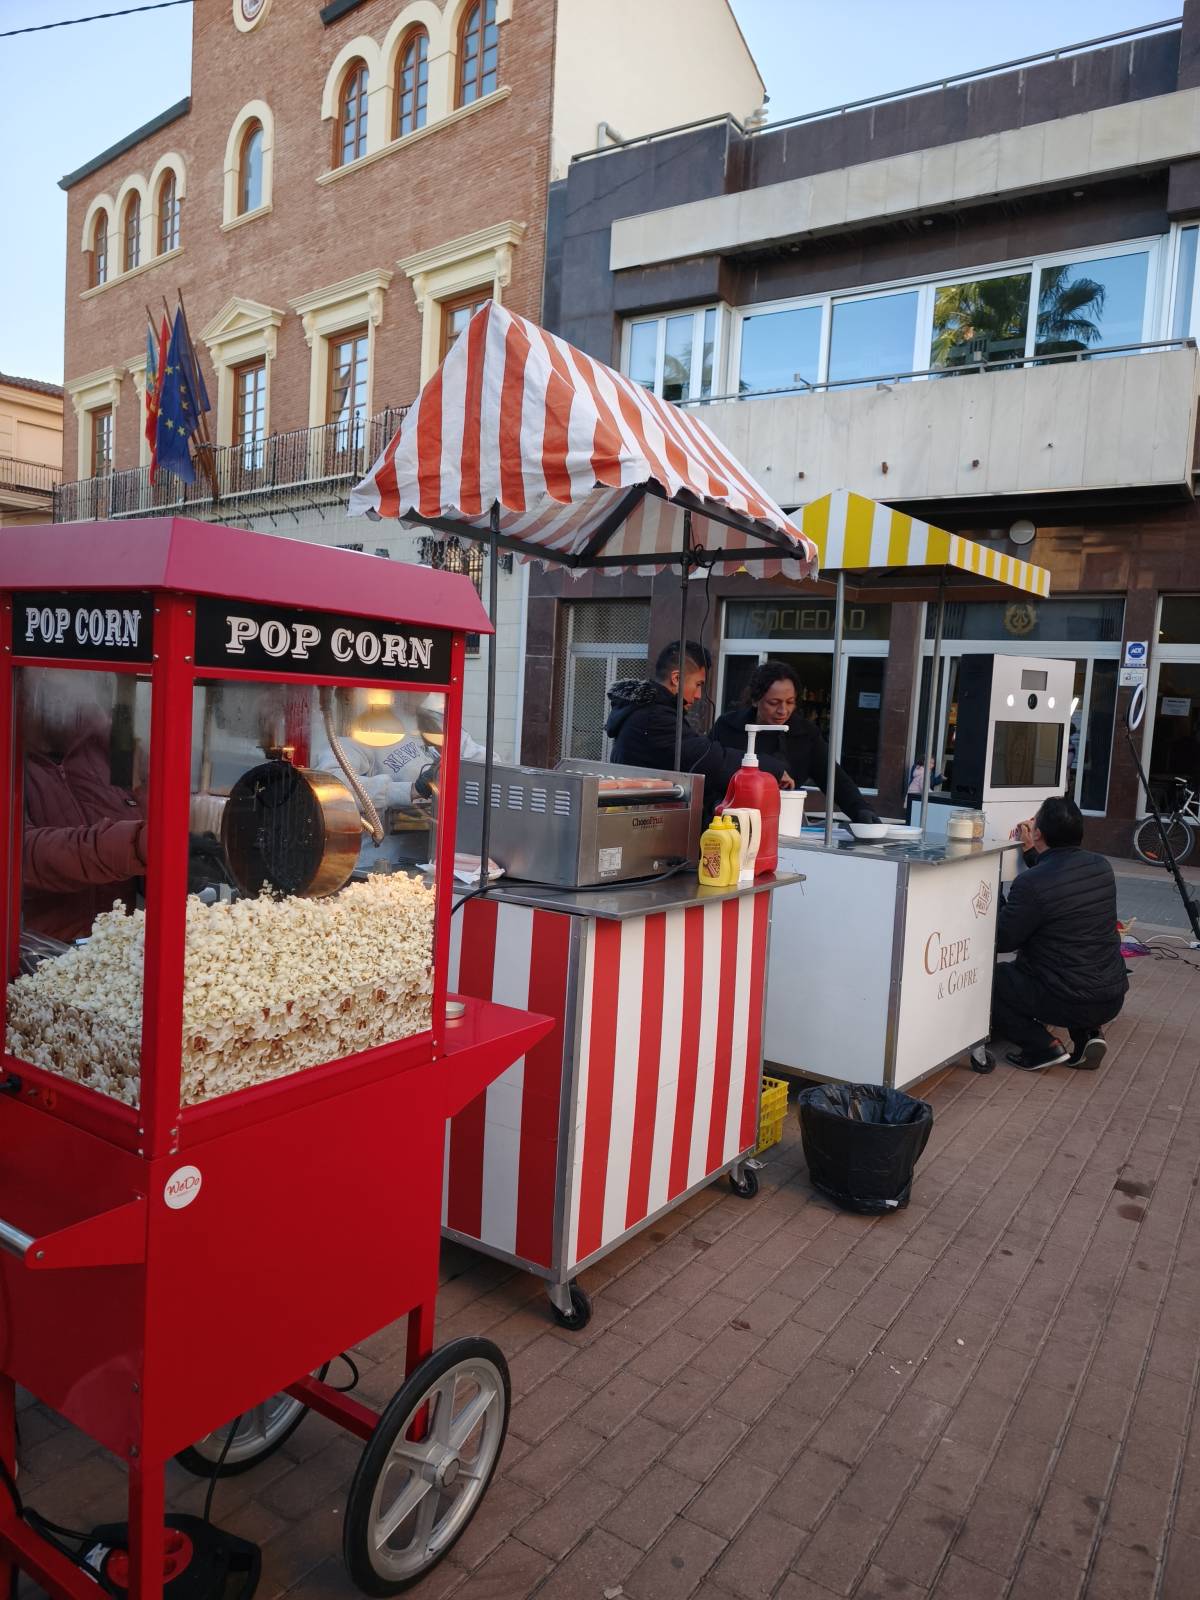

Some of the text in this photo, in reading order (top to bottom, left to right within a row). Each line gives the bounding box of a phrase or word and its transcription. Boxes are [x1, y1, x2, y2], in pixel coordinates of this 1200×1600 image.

[25, 607, 142, 647] POP CORN
[225, 616, 433, 669] POP CORN
[383, 741, 417, 773] NEW
[937, 982, 944, 1001] &
